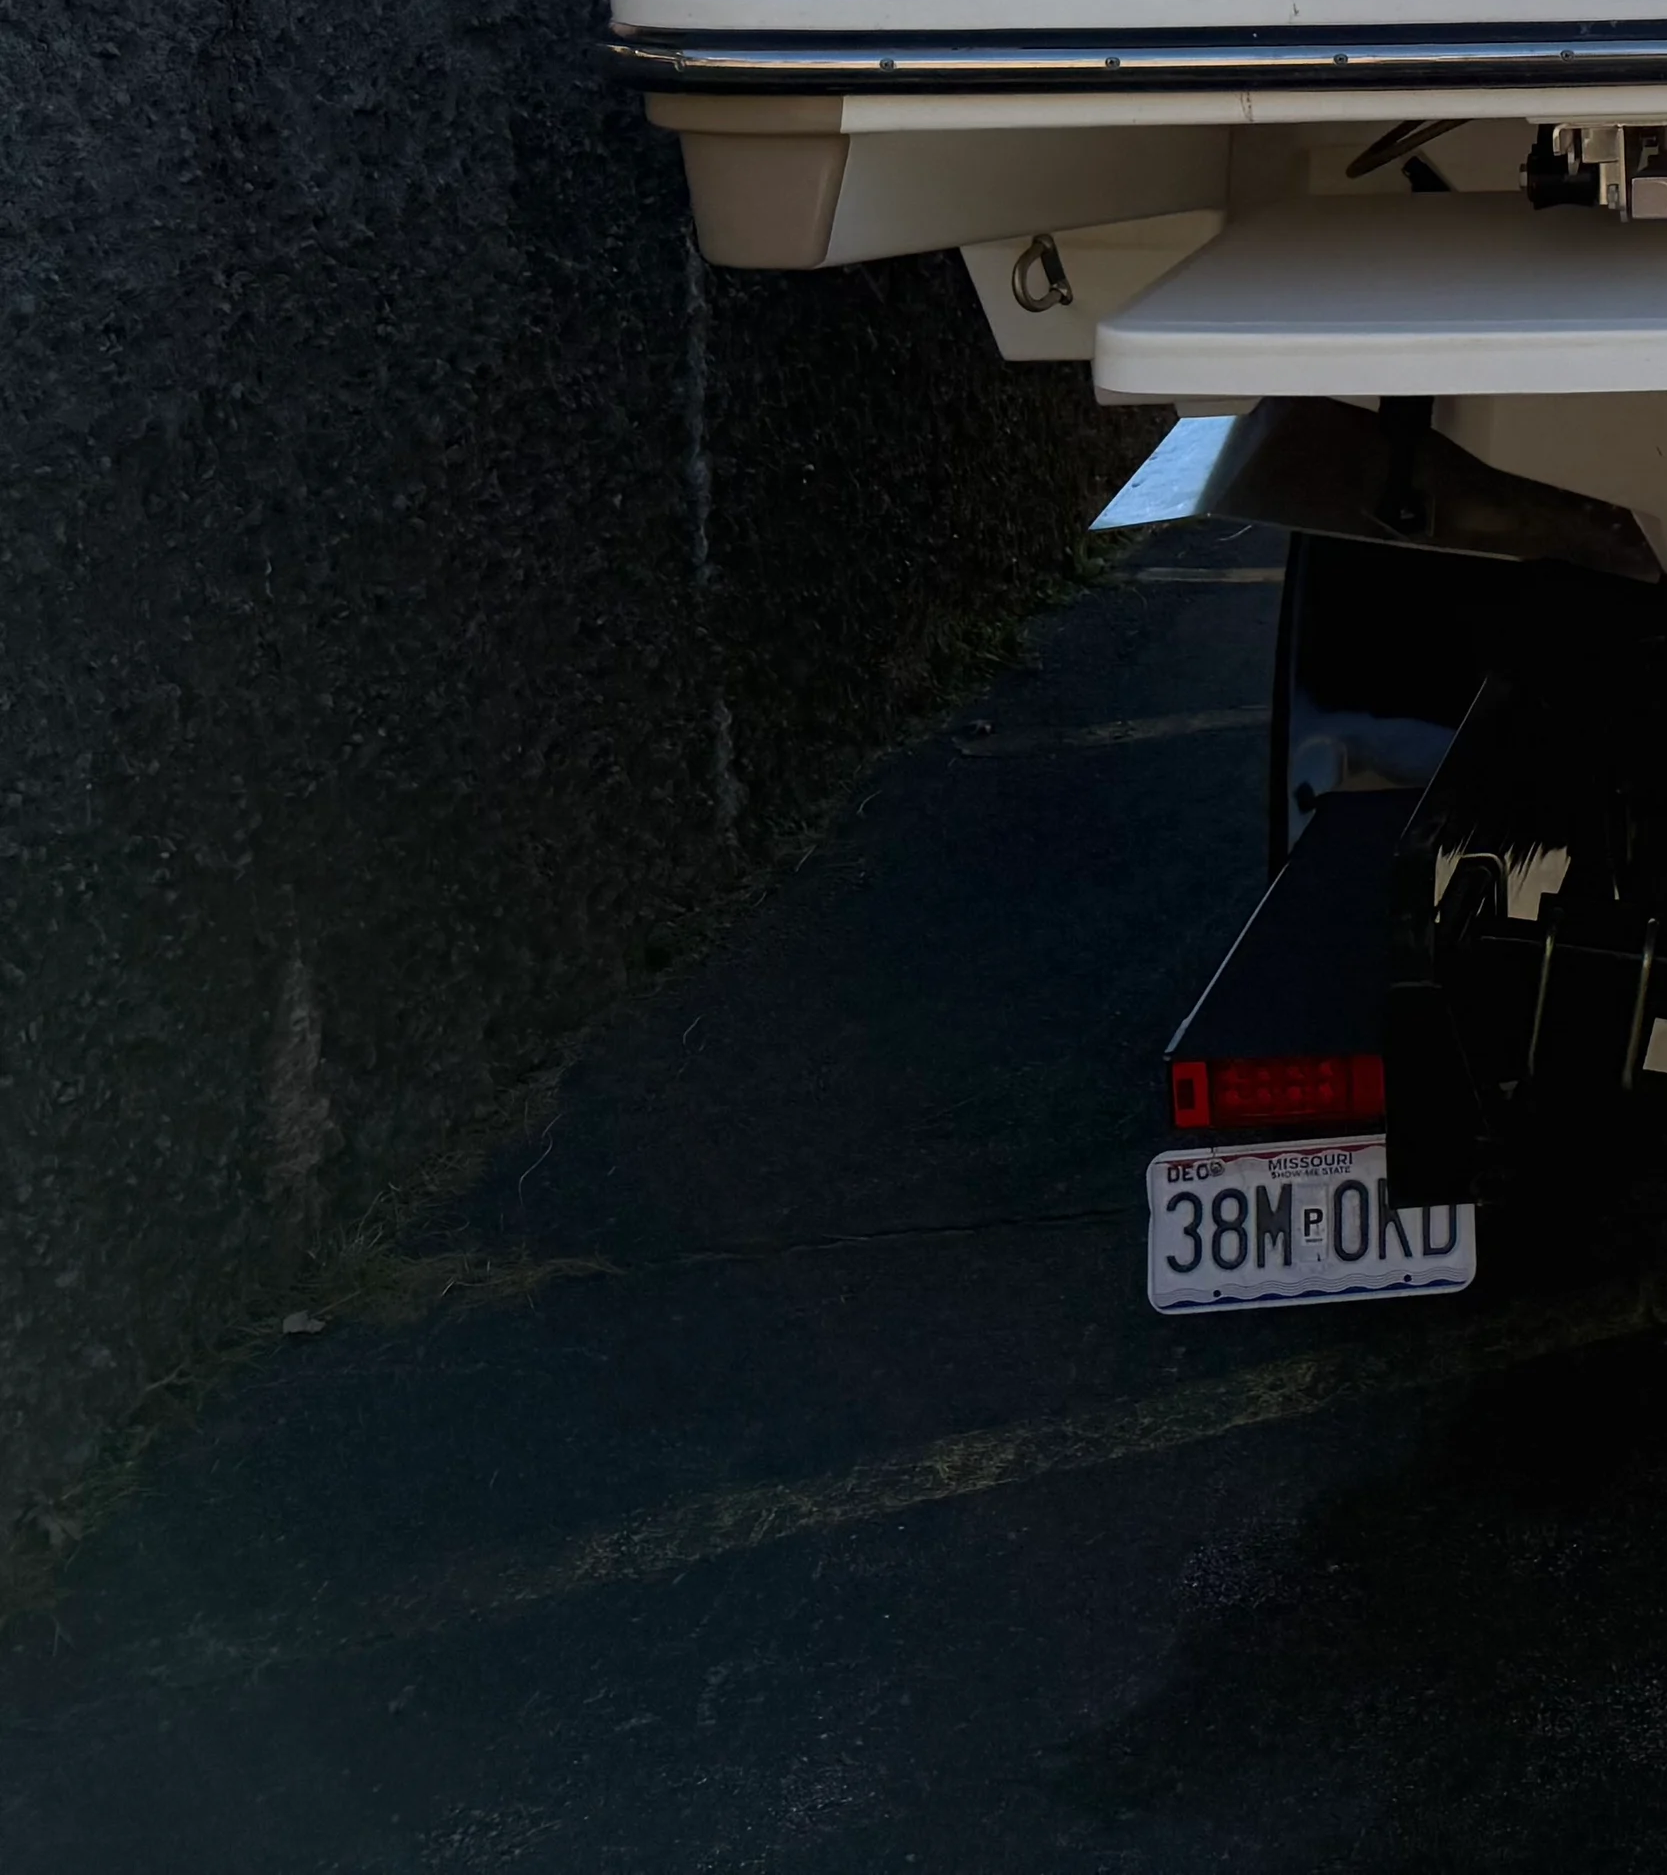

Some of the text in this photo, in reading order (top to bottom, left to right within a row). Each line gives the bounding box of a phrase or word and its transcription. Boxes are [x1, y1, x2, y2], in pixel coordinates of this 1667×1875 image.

[1268, 1152, 1353, 1171] MISSOURI
[1166, 1183, 1293, 1274] 38M
[1303, 1208, 1323, 1237] P
